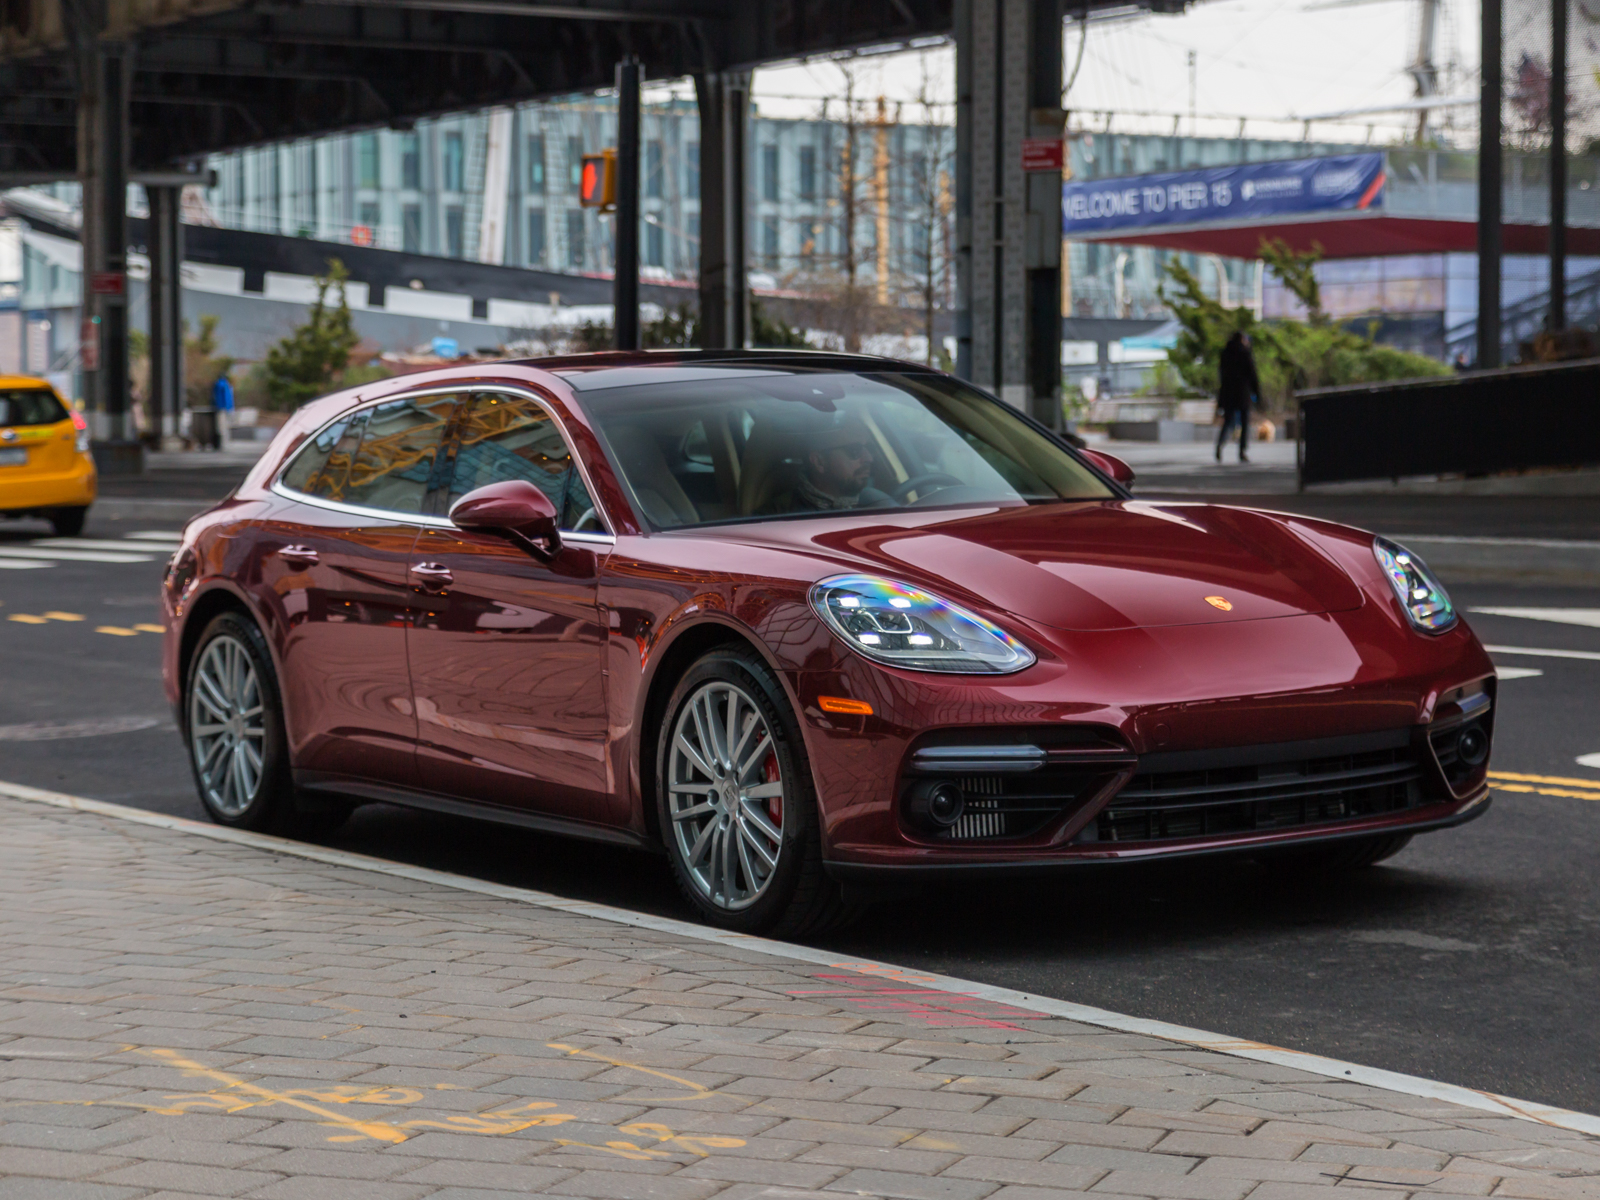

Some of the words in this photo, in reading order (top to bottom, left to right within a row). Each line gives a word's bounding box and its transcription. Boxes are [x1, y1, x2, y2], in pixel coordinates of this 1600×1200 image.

[1062, 188, 1140, 220] WELCOME
[1141, 185, 1167, 214] TO
[1167, 181, 1209, 212] PIER
[1211, 179, 1233, 207] 15
[742, 673, 784, 738] MICHELIN
[782, 748, 792, 772] PILOT
